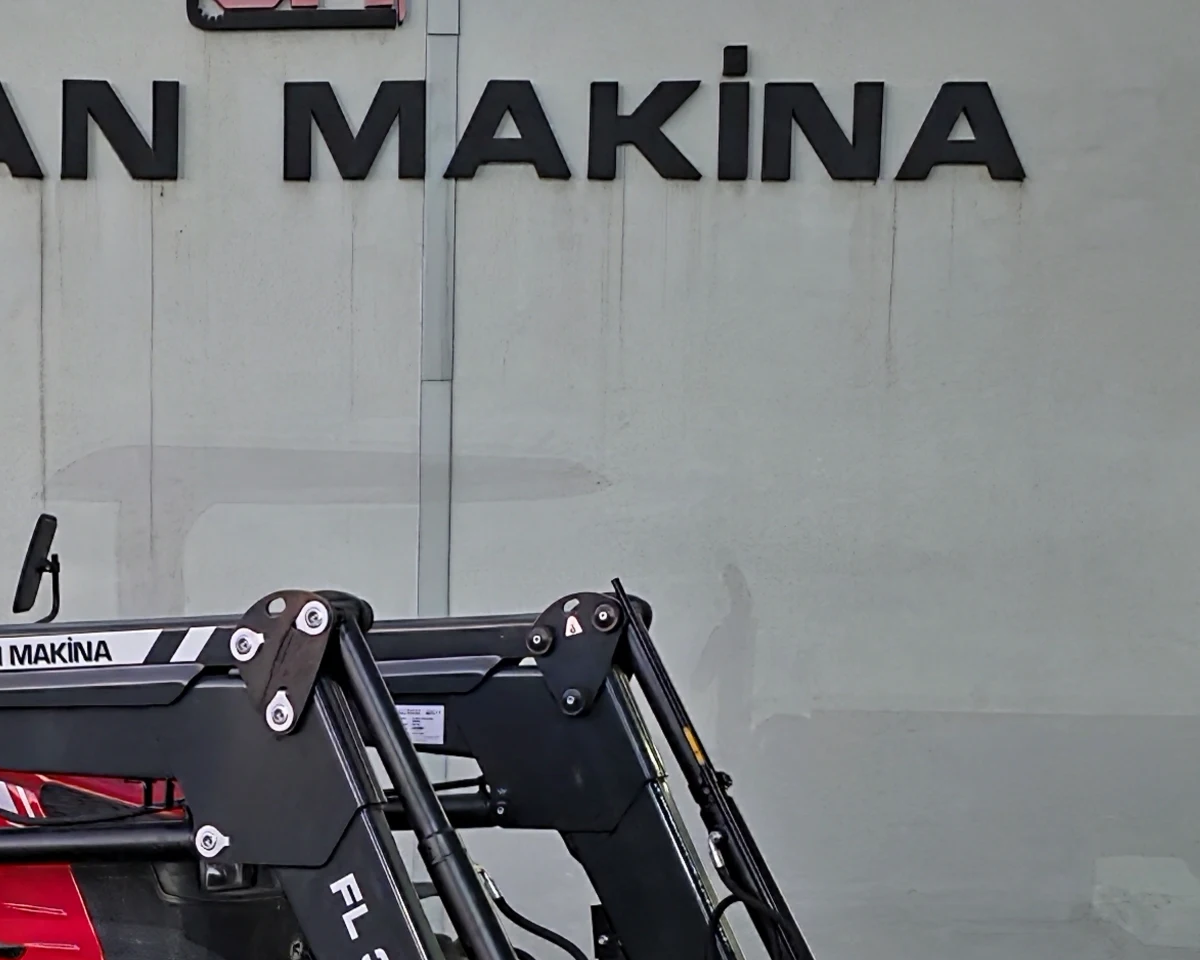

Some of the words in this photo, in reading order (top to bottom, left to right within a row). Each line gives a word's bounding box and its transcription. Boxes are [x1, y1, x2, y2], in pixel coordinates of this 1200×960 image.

[283, 45, 1027, 182] MAKİNA
[9, 636, 113, 667] MAKİNA
[329, 872, 369, 941] FL
